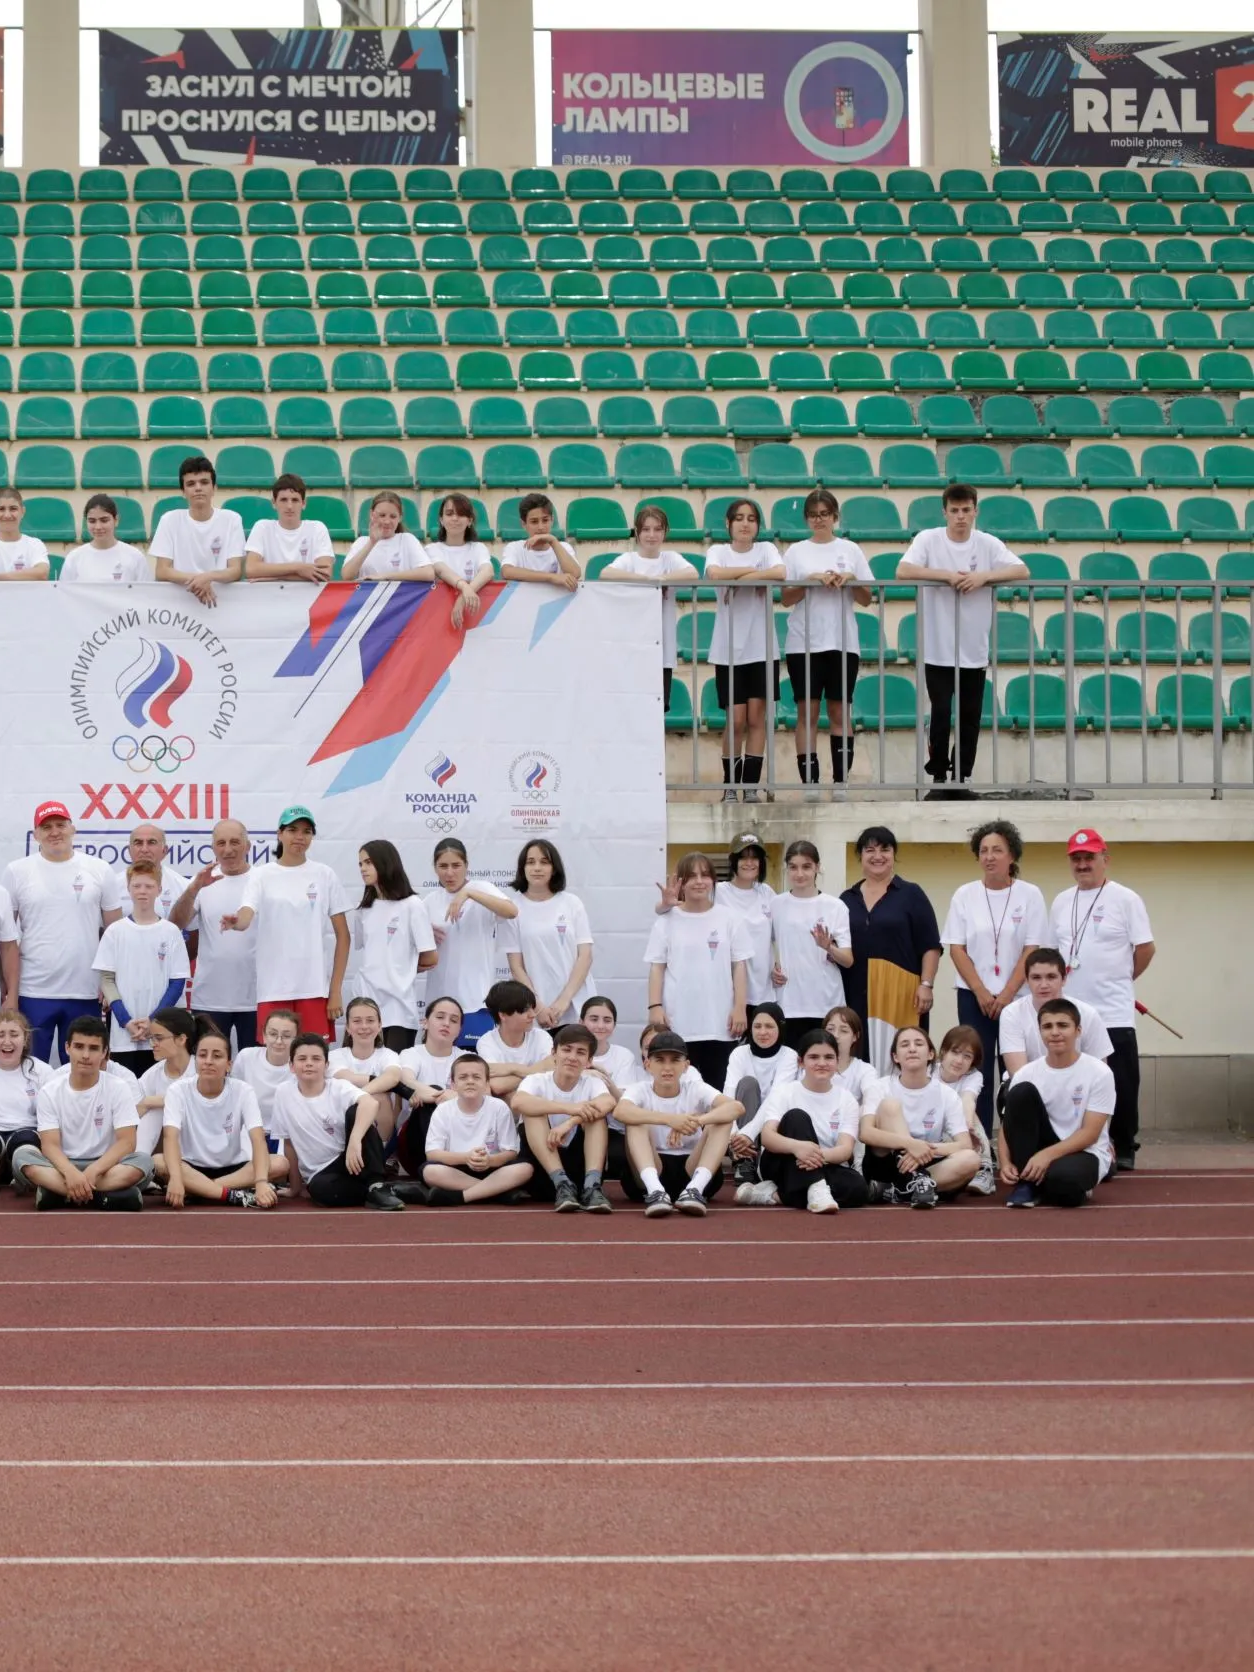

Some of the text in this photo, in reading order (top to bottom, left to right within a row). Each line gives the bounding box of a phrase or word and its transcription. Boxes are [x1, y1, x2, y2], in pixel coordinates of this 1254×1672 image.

[146, 70, 411, 98] ЗАСНУЛ С МЕЧТОЙ!
[562, 73, 764, 103] КОЛЬЦЕВЫЕ
[121, 109, 436, 135] ПРОСНУЛСЯ С ЦЕЛЬЮ!
[562, 107, 689, 133] ЛАМПЫ
[1073, 88, 1209, 133] REAL
[1110, 136, 1183, 150] mobile phones
[574, 155, 631, 165] REAL2.RU
[71, 608, 237, 740] ОЛИМПИЙСКИЙ КОМИТЕТ РОССИИ
[405, 793, 478, 804] КОМАНДА
[412, 804, 470, 814] РОССИИ
[510, 808, 560, 817] ОЛИМПИЙСКАЯ
